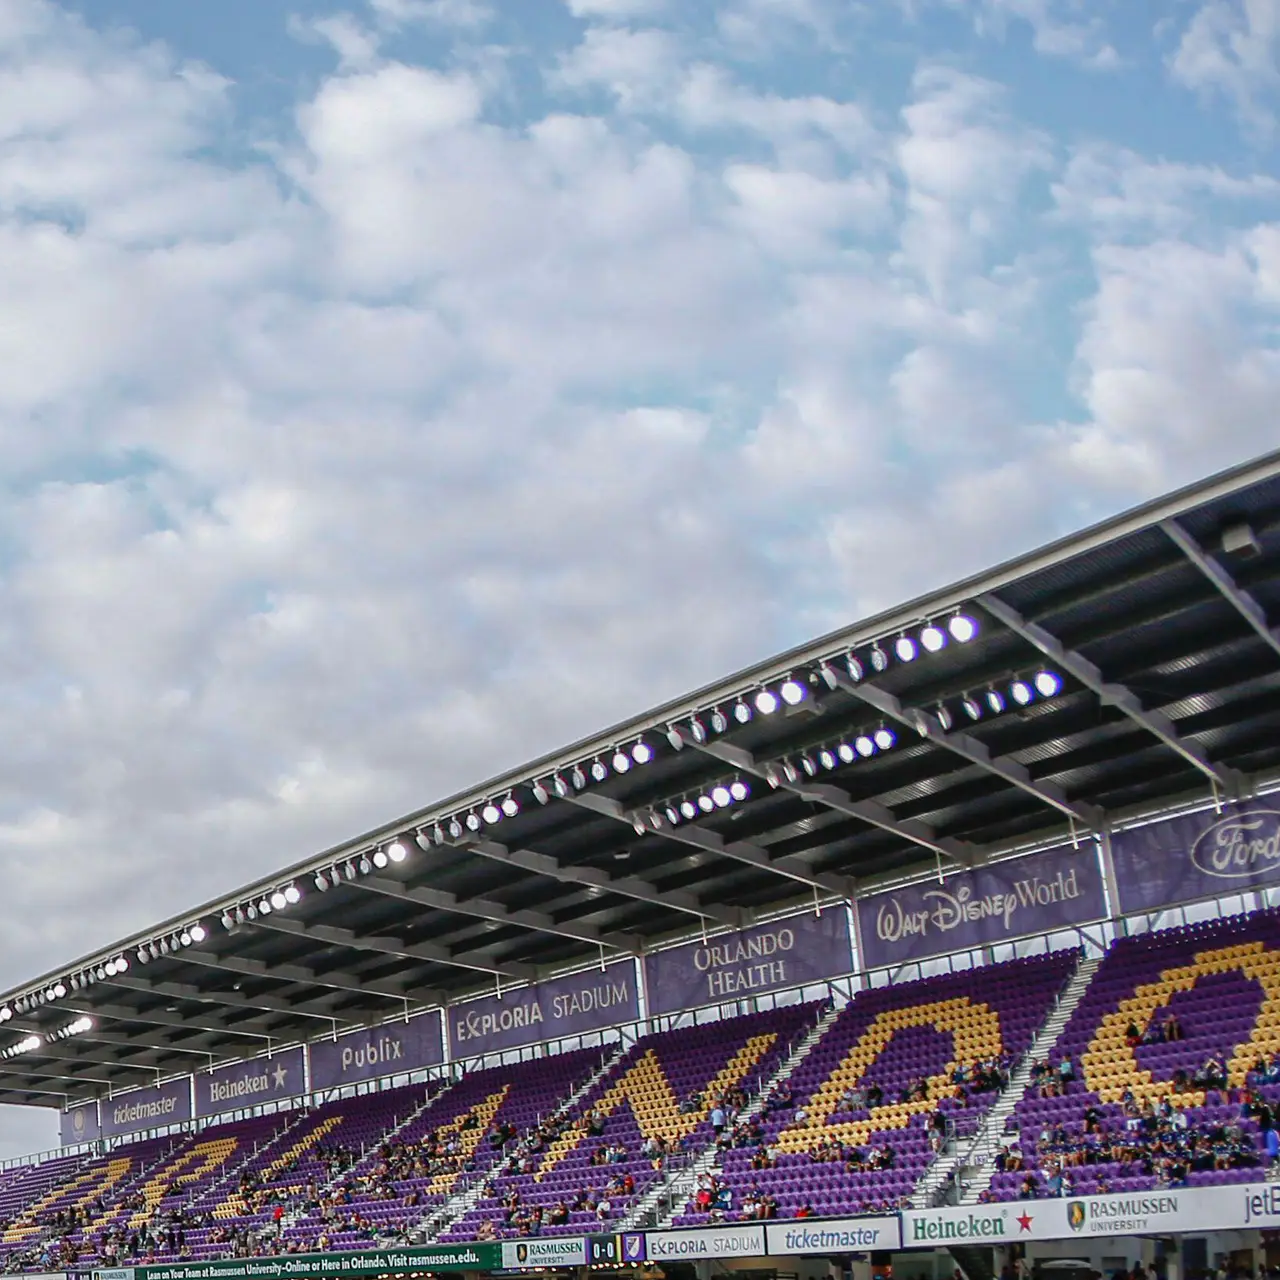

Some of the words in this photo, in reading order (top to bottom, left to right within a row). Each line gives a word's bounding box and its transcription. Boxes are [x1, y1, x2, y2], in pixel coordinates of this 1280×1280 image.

[1013, 868, 1079, 909] World
[693, 928, 795, 971] ORLANDO
[707, 960, 787, 998] HEALTH
[456, 1001, 544, 1042] EXPLORIA
[552, 981, 629, 1020] STADIUM
[341, 1037, 403, 1072] Publix
[209, 1072, 269, 1104] Heineken
[113, 1096, 178, 1126] ticketmaster
[1089, 1197, 1178, 1218] RASMUSSEN
[785, 1226, 880, 1248] ticketmaster
[913, 1213, 1005, 1241] Heineken
[1090, 1218, 1148, 1233] UNIVERSITY
[529, 1241, 583, 1256] RASMUSSEN
[529, 1255, 565, 1265] UNIVERSITY
[593, 1243, 614, 1259] 0-0
[651, 1236, 708, 1256] EXPLORIA
[713, 1235, 761, 1252] STADIUM
[146, 1269, 161, 1280] Lean
[161, 1270, 169, 1280] on
[169, 1268, 184, 1280] Your
[184, 1266, 201, 1279] Team
[202, 1268, 209, 1278] at
[209, 1264, 246, 1278] Rasmussen
[311, 1261, 320, 1271] or
[321, 1259, 340, 1272] Here
[341, 1257, 350, 1270] in
[351, 1254, 387, 1269] Orlando.
[387, 1253, 408, 1267] Visit
[408, 1249, 479, 1267] rasmussen.edu.
